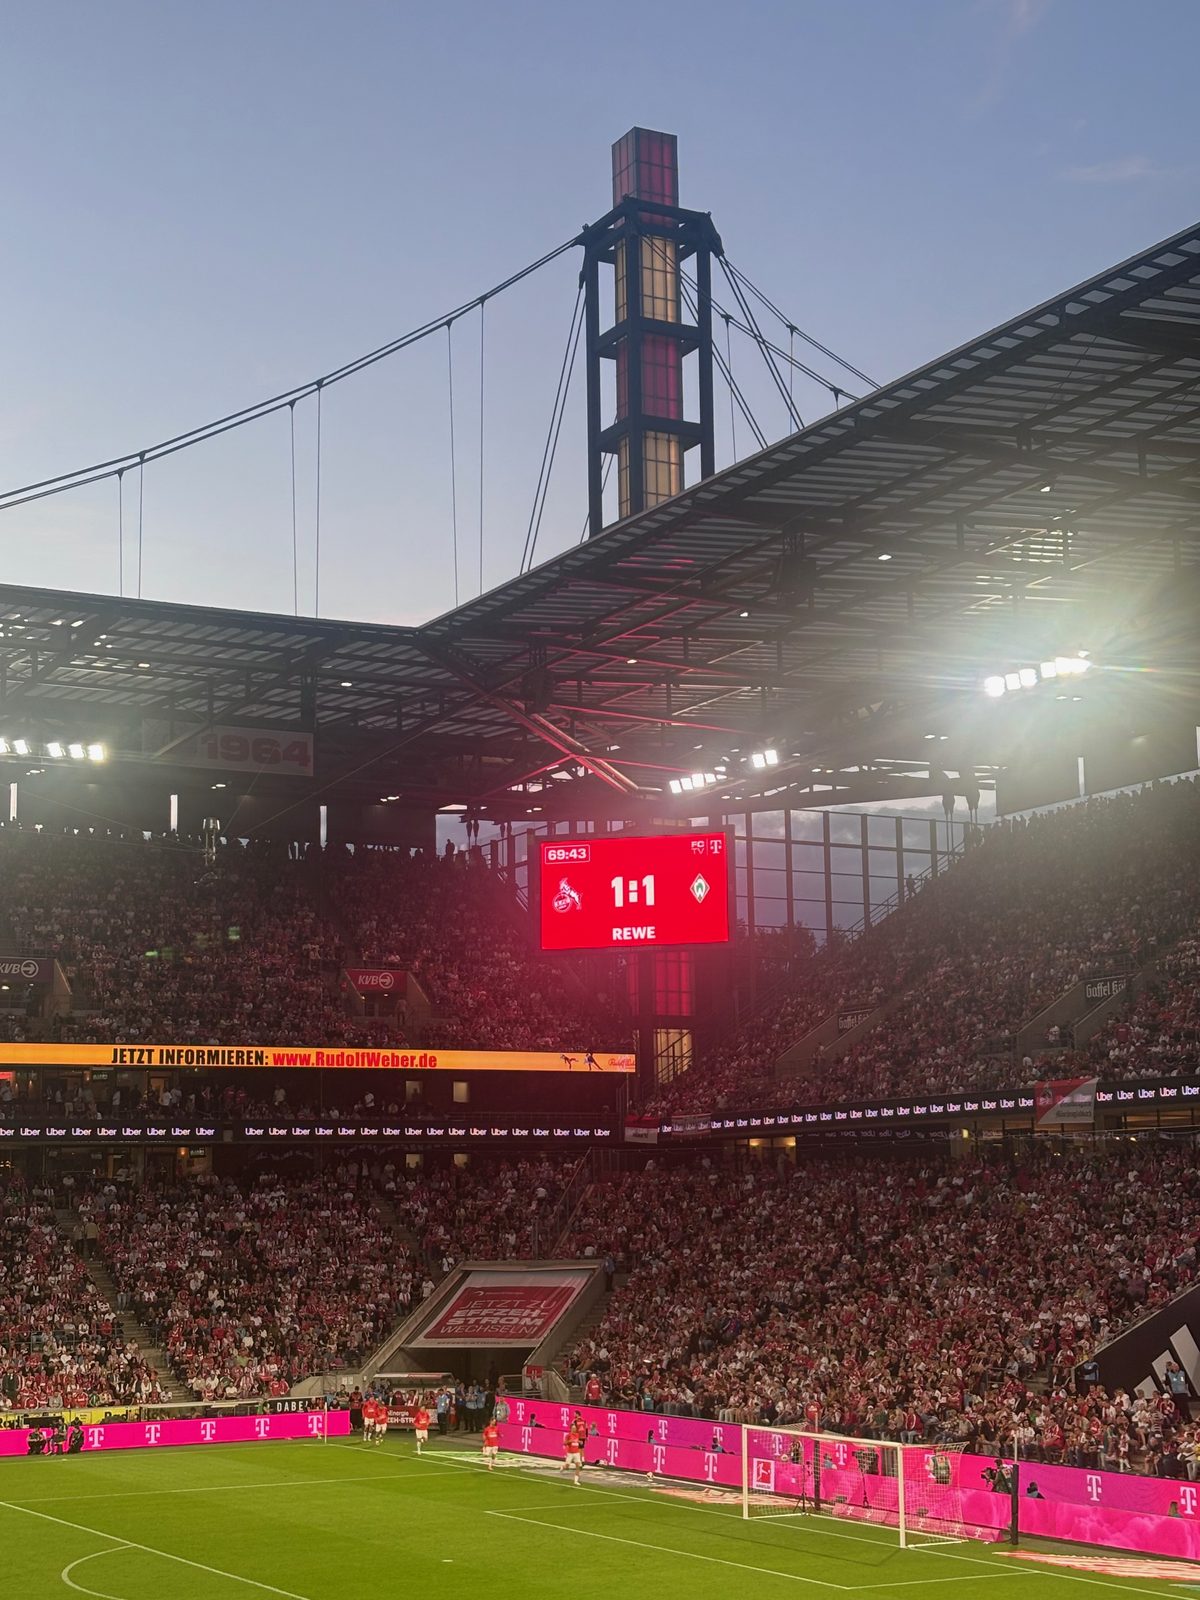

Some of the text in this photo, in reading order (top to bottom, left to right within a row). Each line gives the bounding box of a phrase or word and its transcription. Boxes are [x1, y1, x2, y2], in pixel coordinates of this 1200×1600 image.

[201, 733, 311, 767] 1964
[691, 840, 705, 848] FC
[691, 847, 705, 855] TV
[709, 840, 722, 854] T
[547, 848, 587, 861] 69:43
[611, 874, 655, 908] 1:1
[612, 926, 656, 941] REWE
[358, 975, 379, 985] KVB
[111, 1048, 437, 1068] JETZT INFORMIEREN: www.RudolfWeber.de
[790, 1114, 804, 1123] Uber
[805, 1113, 818, 1122] Uber
[819, 1112, 833, 1121] Uber
[834, 1111, 848, 1120] Uber
[849, 1110, 863, 1119] Uber
[865, 1109, 879, 1118] Uber
[880, 1107, 894, 1117] Uber
[896, 1106, 911, 1116] Uber
[913, 1105, 927, 1115] Uber
[929, 1104, 944, 1113] Uber
[946, 1102, 961, 1112] Uber
[963, 1101, 979, 1111] Uber
[981, 1100, 997, 1110] Uber
[999, 1099, 1016, 1109] Uber
[1018, 1097, 1034, 1107] Uber
[1096, 1091, 1113, 1102] Uber
[1116, 1090, 1134, 1100] Uber
[1138, 1089, 1156, 1099] Uber
[1159, 1087, 1178, 1097] Uber
[1181, 1085, 1200, 1096] Uber
[19, 1127, 41, 1136] Uber
[45, 1127, 67, 1136] Uber
[71, 1127, 92, 1136] Uber
[96, 1127, 118, 1136] Uber
[121, 1127, 142, 1136] Uber
[146, 1127, 167, 1136] Uber
[171, 1127, 191, 1136] Uber
[195, 1127, 216, 1136] Uber
[244, 1127, 611, 1137] Uber Uber Uber Uber Uber Uber Uber Uber Uber Uber Uber Uber Uber Uber Uber Uber Uber
[452, 1309, 549, 1318] EFFZEH-
[459, 1300, 556, 1309] JETZT ZU
[446, 1317, 545, 1326] STROM
[517, 1402, 525, 1421] T
[560, 1407, 569, 1427] T
[201, 1421, 216, 1441] T
[255, 1418, 270, 1437] T
[307, 1415, 323, 1434] T
[607, 1413, 617, 1434] T
[658, 1419, 668, 1441] T
[89, 1427, 105, 1448] T
[145, 1424, 161, 1444] T
[521, 1426, 532, 1453] T
[607, 1438, 618, 1466] T
[653, 1444, 666, 1474] T
[835, 1443, 848, 1466] T
[704, 1452, 718, 1482] T
[1086, 1474, 1102, 1502] T
[1180, 1485, 1197, 1515] T
